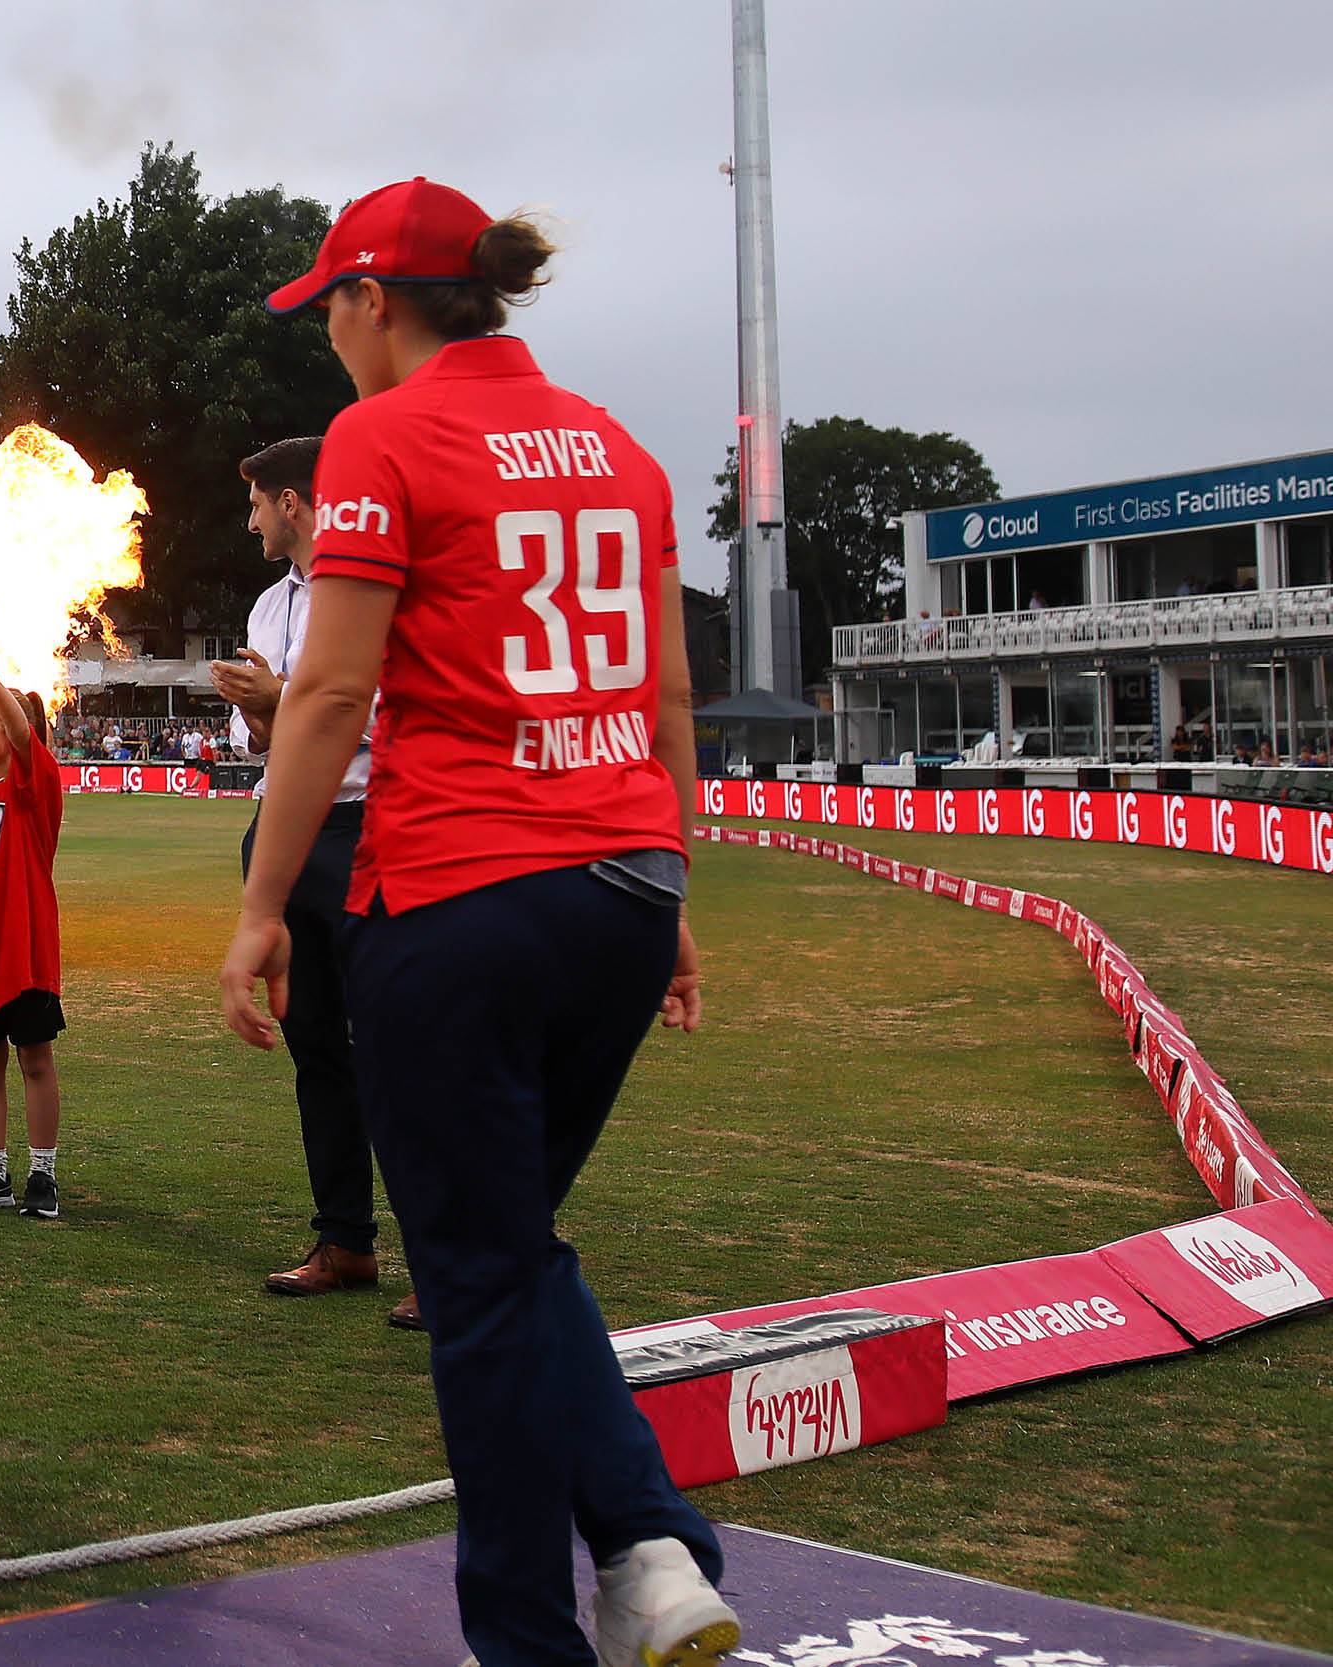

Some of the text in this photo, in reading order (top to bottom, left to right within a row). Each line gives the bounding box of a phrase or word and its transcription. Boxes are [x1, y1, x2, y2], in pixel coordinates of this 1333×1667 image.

[355, 251, 376, 265] 34
[484, 428, 616, 481] SCIVER
[988, 511, 1039, 539] Cloud
[1075, 503, 1116, 529] First
[1121, 497, 1172, 524] Class
[1176, 482, 1271, 516] Facilities
[495, 508, 647, 696] 39
[511, 711, 651, 771] ENGLAND
[80, 766, 100, 788] IG
[122, 766, 143, 792] IG
[166, 767, 187, 793] IG
[704, 779, 1333, 874] IG IG IG IG IG IG IG IG IG IG IG IG IG IG IG
[1188, 1235, 1298, 1288] Vitality
[945, 1295, 1127, 1352] insurance
[746, 1372, 850, 1461] Vitality
